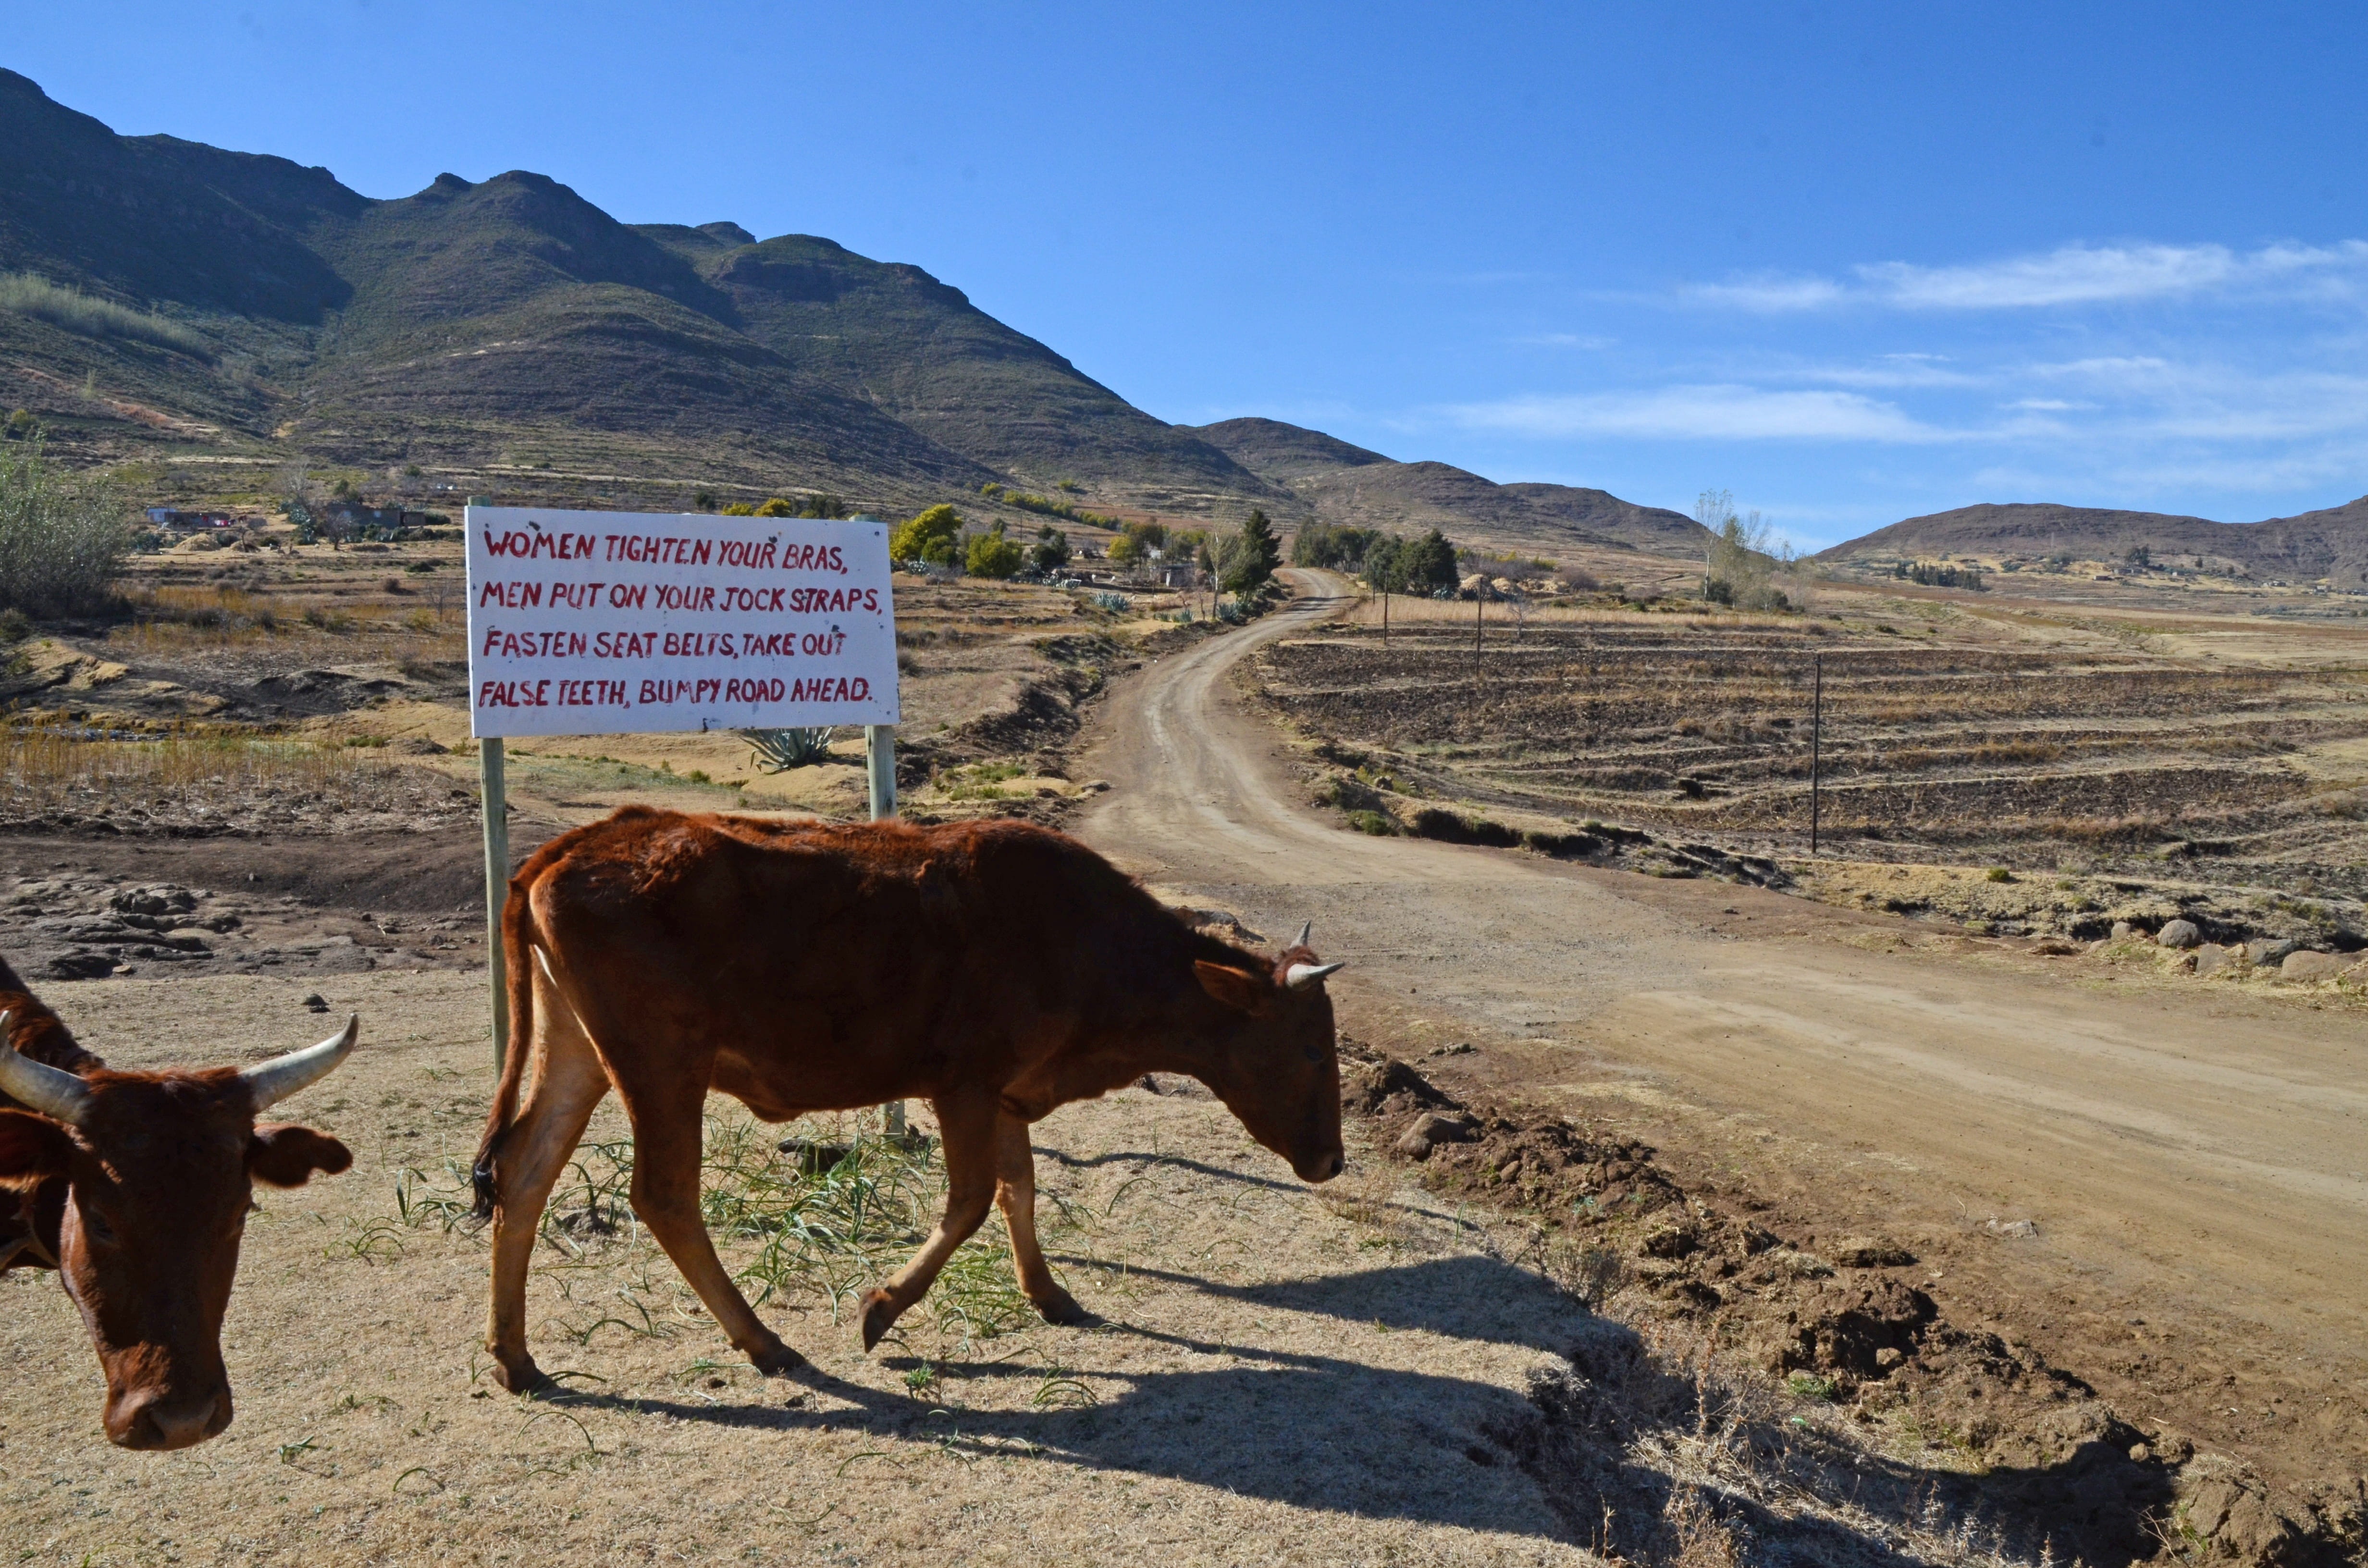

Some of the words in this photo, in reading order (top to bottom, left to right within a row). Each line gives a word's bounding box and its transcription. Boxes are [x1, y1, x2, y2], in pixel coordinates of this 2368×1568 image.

[484, 530, 596, 560] WOMEN
[605, 535, 712, 564] TIGHTEN
[717, 540, 776, 569] YOUR
[782, 544, 848, 575] BRAS,
[480, 582, 542, 608] MEN
[549, 583, 604, 609] PUT
[610, 583, 647, 610] ON
[655, 584, 715, 612] YOUR
[720, 587, 786, 612] JOCK
[789, 588, 882, 614] STRAPS,
[483, 630, 586, 658] FASTEN
[593, 632, 658, 658] SEAT
[802, 632, 847, 656] OUT
[479, 679, 550, 708] FALSE
[558, 679, 630, 709] TEETH,
[639, 679, 721, 704] BUMPY
[726, 678, 785, 702] ROAD
[790, 677, 873, 702] AHEAD.
